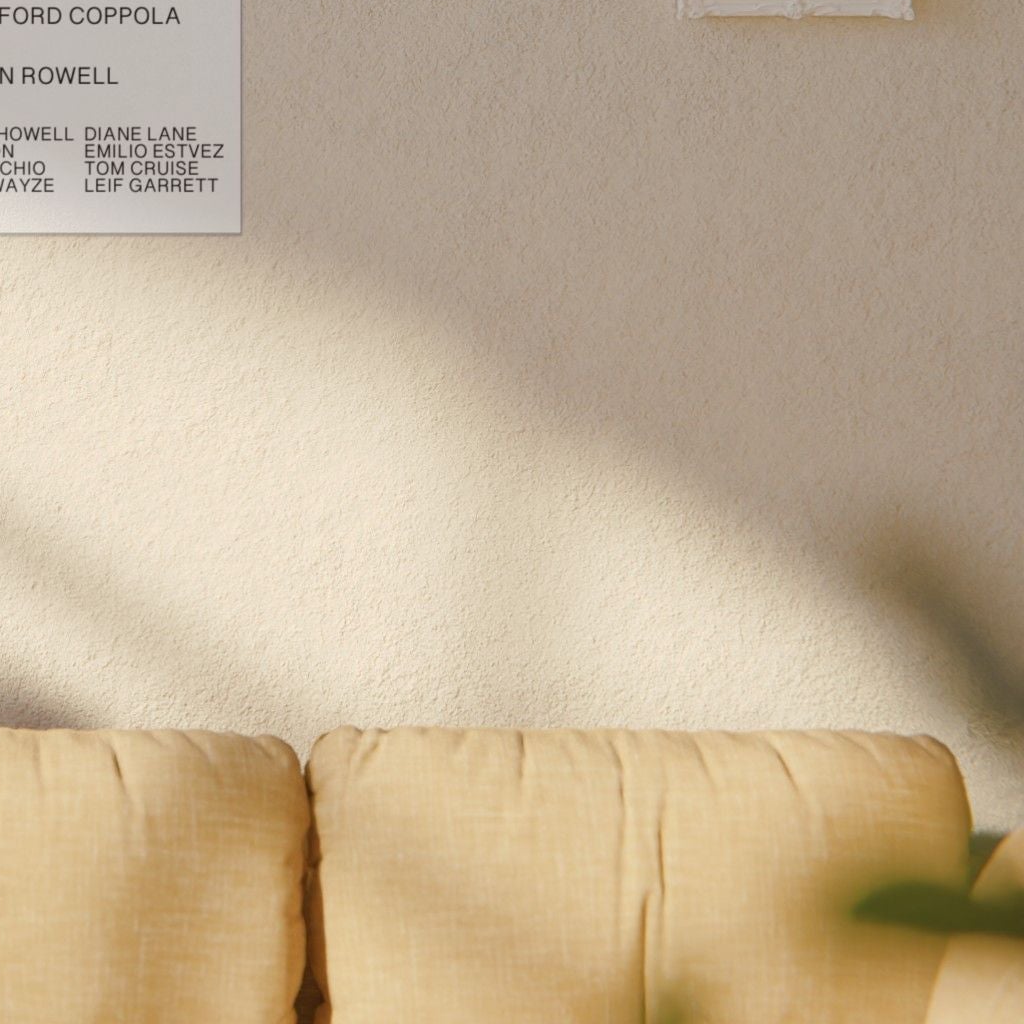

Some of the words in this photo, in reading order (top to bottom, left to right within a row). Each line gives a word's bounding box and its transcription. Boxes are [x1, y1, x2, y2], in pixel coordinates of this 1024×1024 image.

[0, 7, 62, 25] FORD
[69, 7, 180, 25] COPPOLA
[22, 66, 118, 85] ROWELL
[85, 127, 141, 141] DIANE
[148, 127, 196, 141] LANE
[85, 144, 147, 158] EMILIO
[153, 144, 224, 158] ESTVEZ
[85, 161, 124, 175] TOM
[131, 161, 198, 175] CRUISE
[85, 178, 123, 192] LEIF
[129, 178, 218, 192] GARRETT
